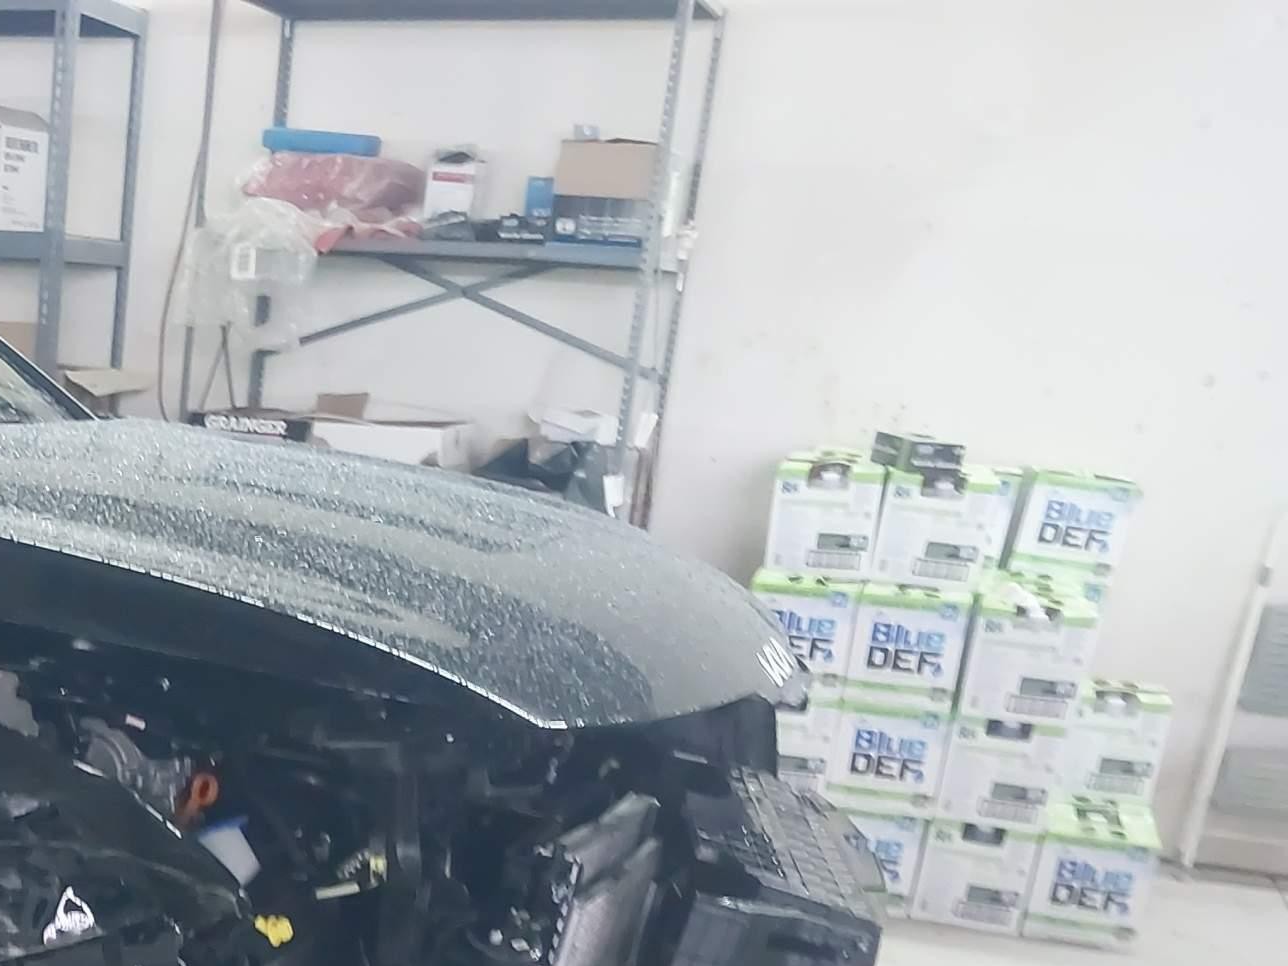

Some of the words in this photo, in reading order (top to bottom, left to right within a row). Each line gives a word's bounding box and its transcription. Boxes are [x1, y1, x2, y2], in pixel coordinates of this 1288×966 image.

[1037, 522, 1112, 551] DEF
[787, 634, 834, 661] EF
[867, 645, 943, 675] DEF
[850, 751, 924, 781] DEF
[1049, 882, 1130, 912] DEF
